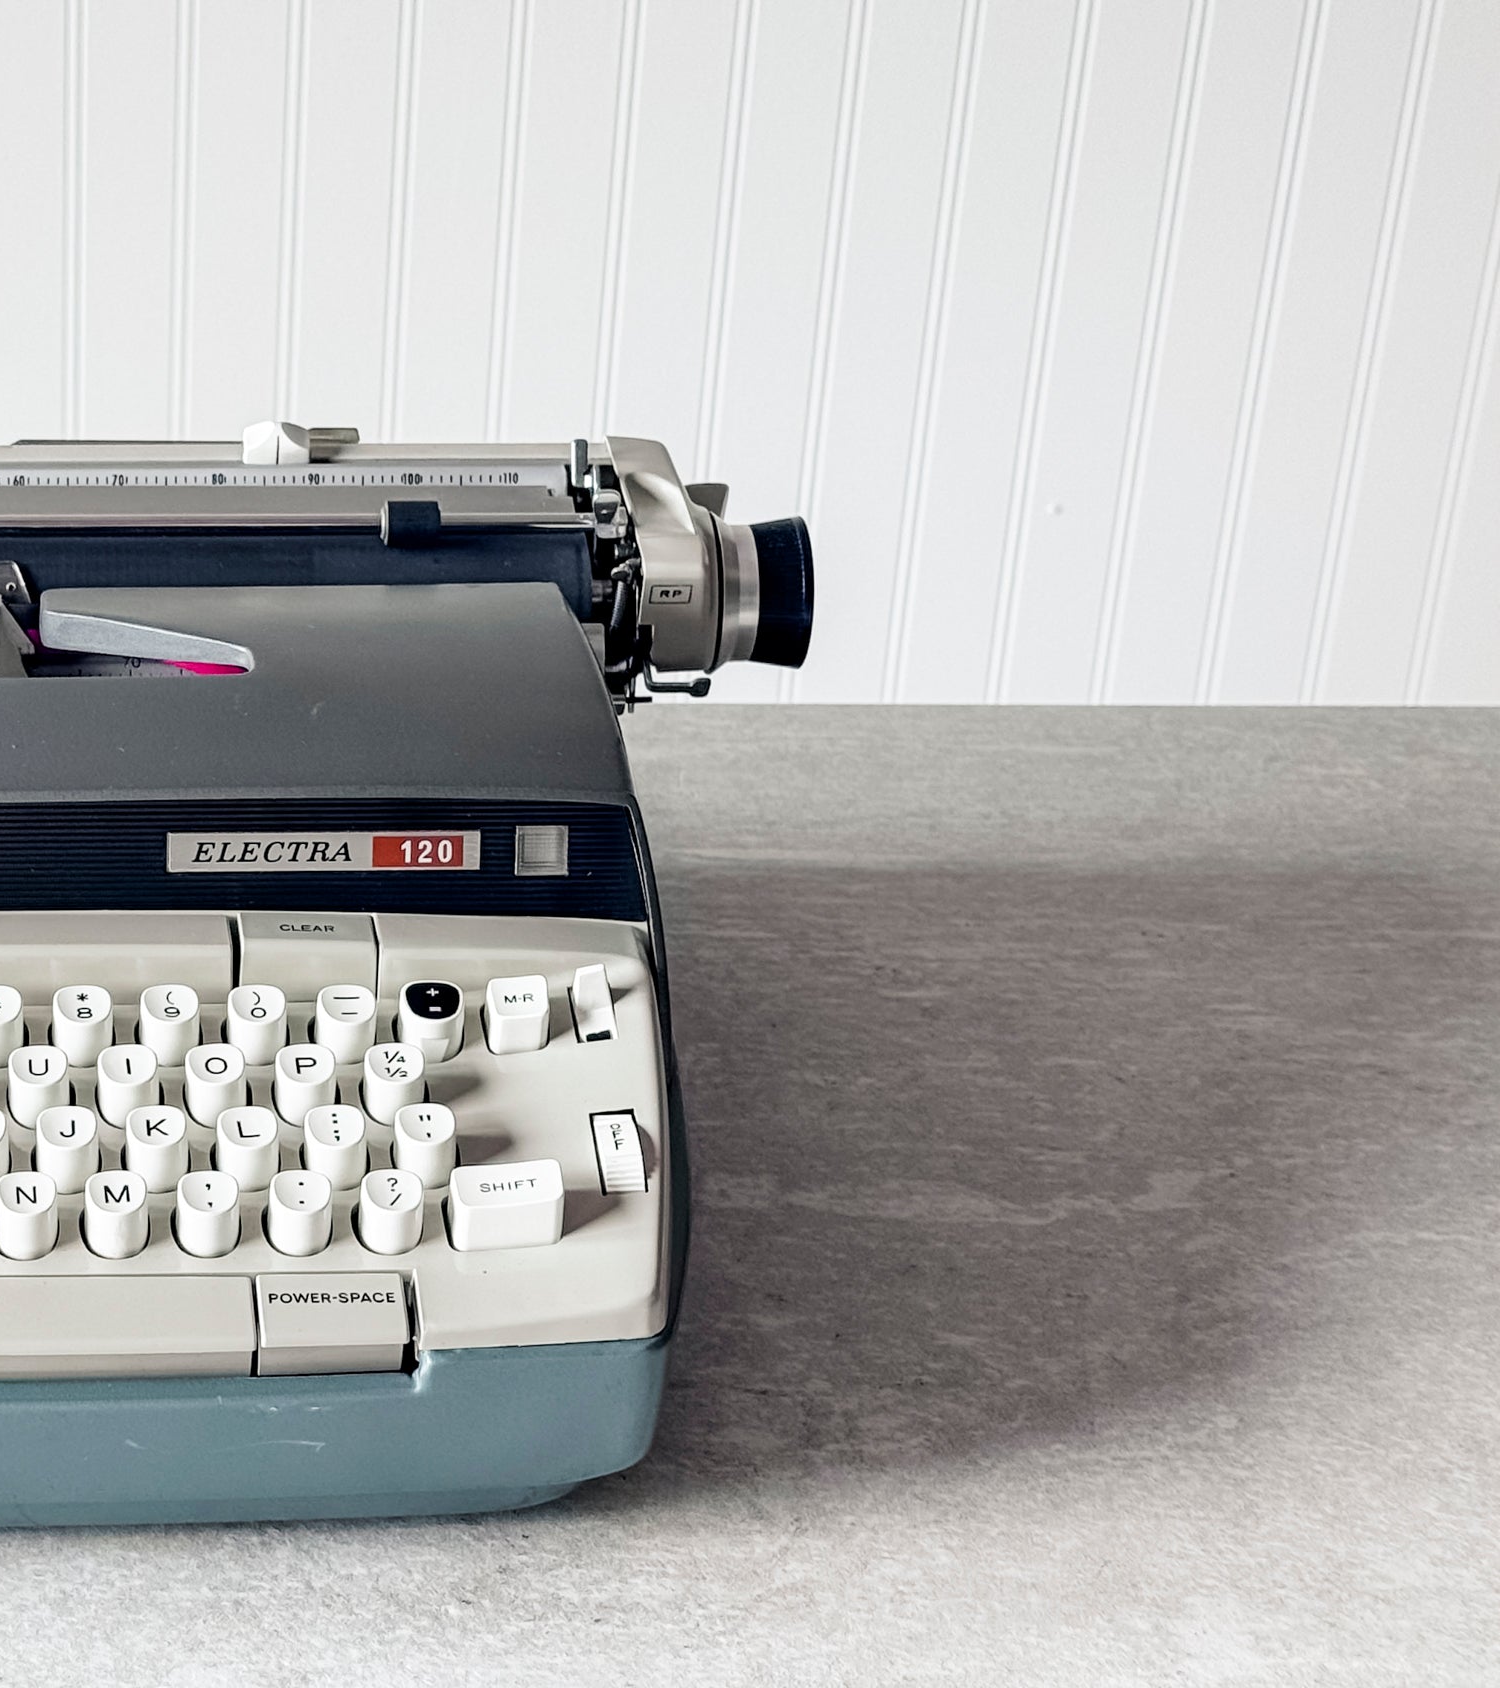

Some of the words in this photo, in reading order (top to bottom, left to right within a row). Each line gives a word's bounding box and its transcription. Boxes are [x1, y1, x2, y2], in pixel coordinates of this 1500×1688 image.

[12, 474, 25, 487] 60
[111, 474, 124, 487] 70
[211, 473, 224, 486] 80
[308, 473, 320, 486] 90
[659, 589, 683, 599] RP
[191, 841, 353, 863] ELECTRA
[400, 839, 453, 864] 120
[279, 923, 335, 933] CLEAR
[76, 1007, 93, 1019] 8
[163, 1006, 181, 1018] 9
[28, 1058, 49, 1077] U
[204, 1056, 228, 1075] O
[295, 1057, 317, 1075] P
[59, 1119, 76, 1138] J
[145, 1118, 169, 1137] K
[236, 1120, 261, 1139] L
[103, 1184, 131, 1204] M
[479, 1178, 537, 1193] SHIFT
[15, 1185, 37, 1205] N
[268, 1292, 396, 1304] POWER-SPACE
